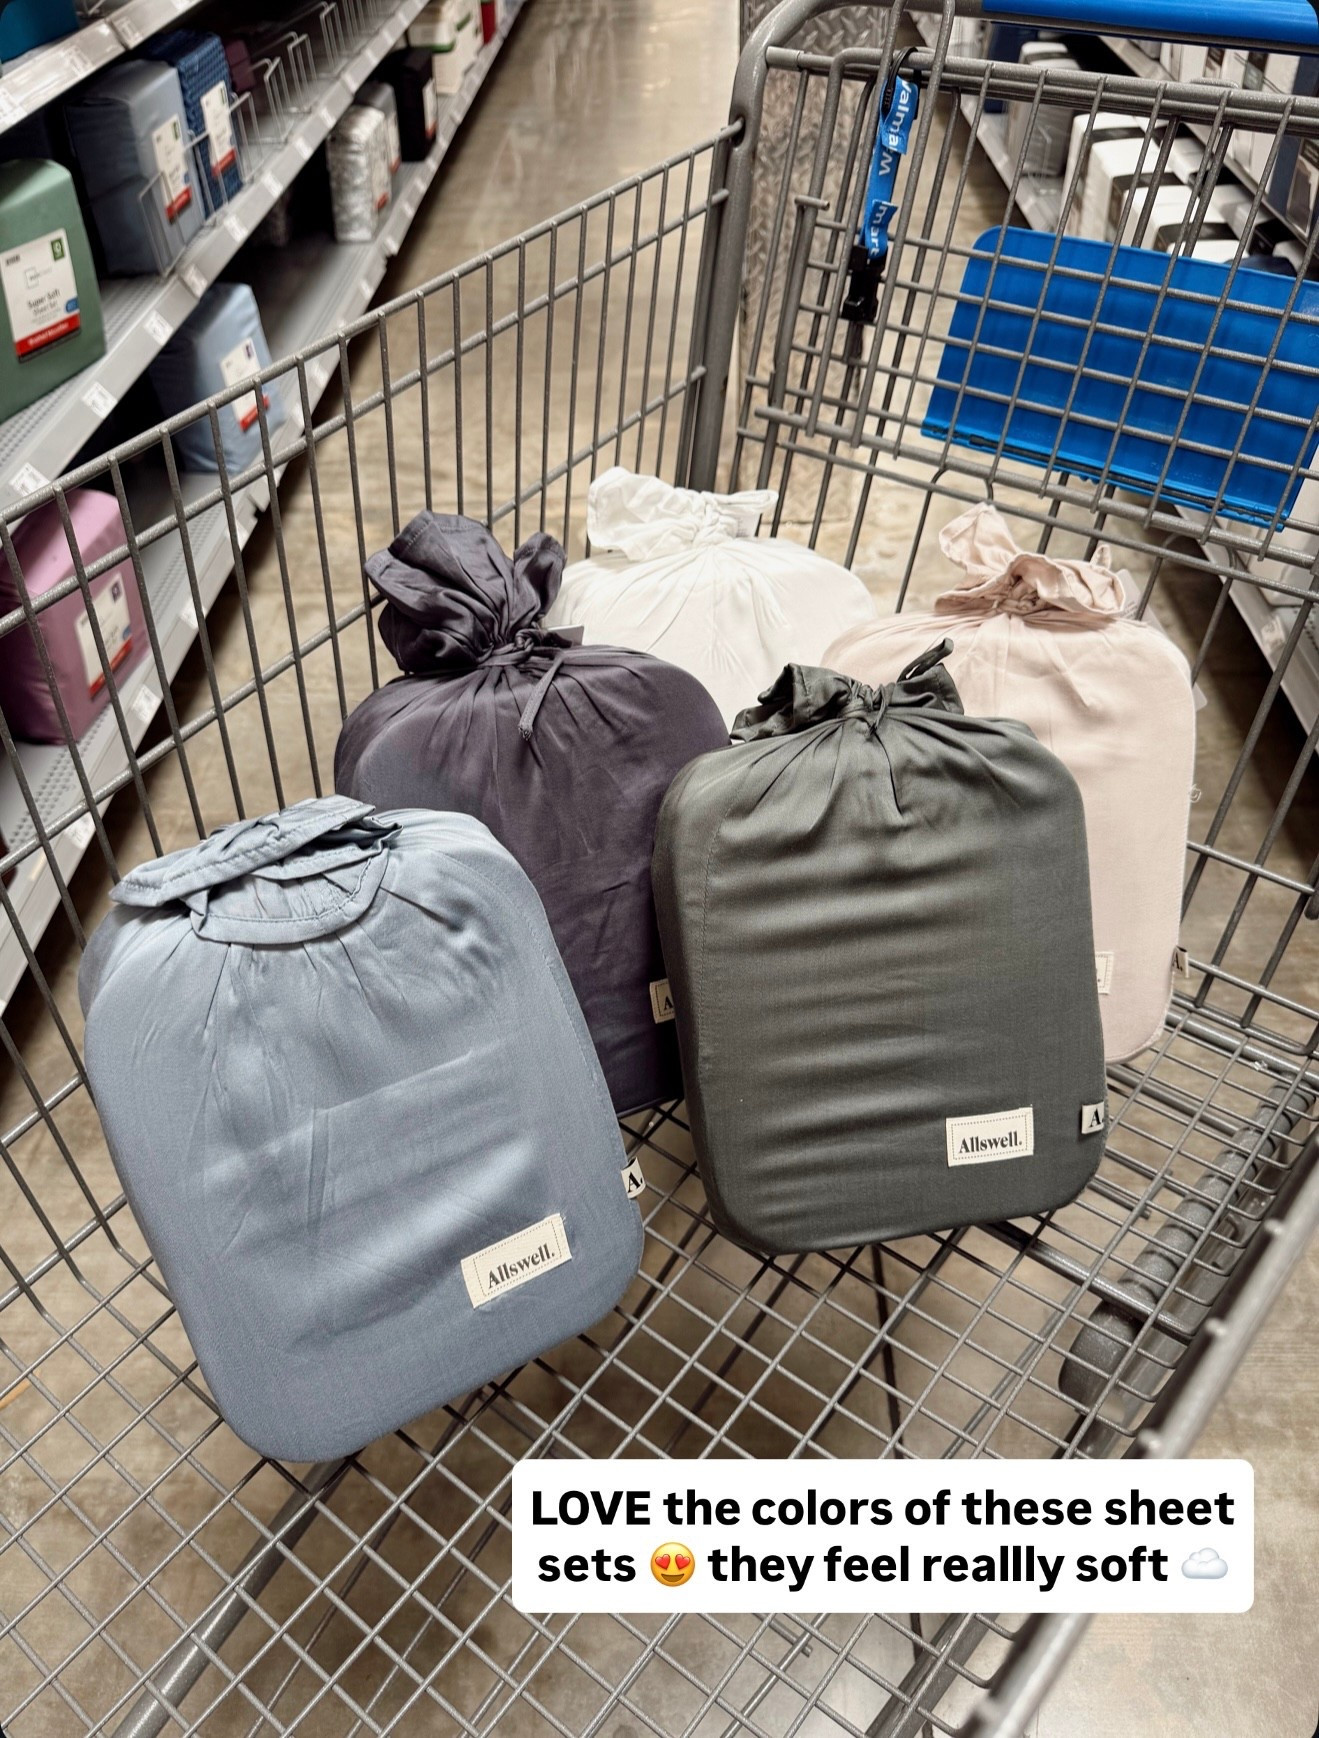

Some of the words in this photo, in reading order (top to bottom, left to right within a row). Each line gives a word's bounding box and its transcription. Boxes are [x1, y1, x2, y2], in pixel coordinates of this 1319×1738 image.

[957, 1130, 1023, 1154] Allswell.
[627, 1172, 644, 1194] A.
[488, 1243, 556, 1289] Allswell.
